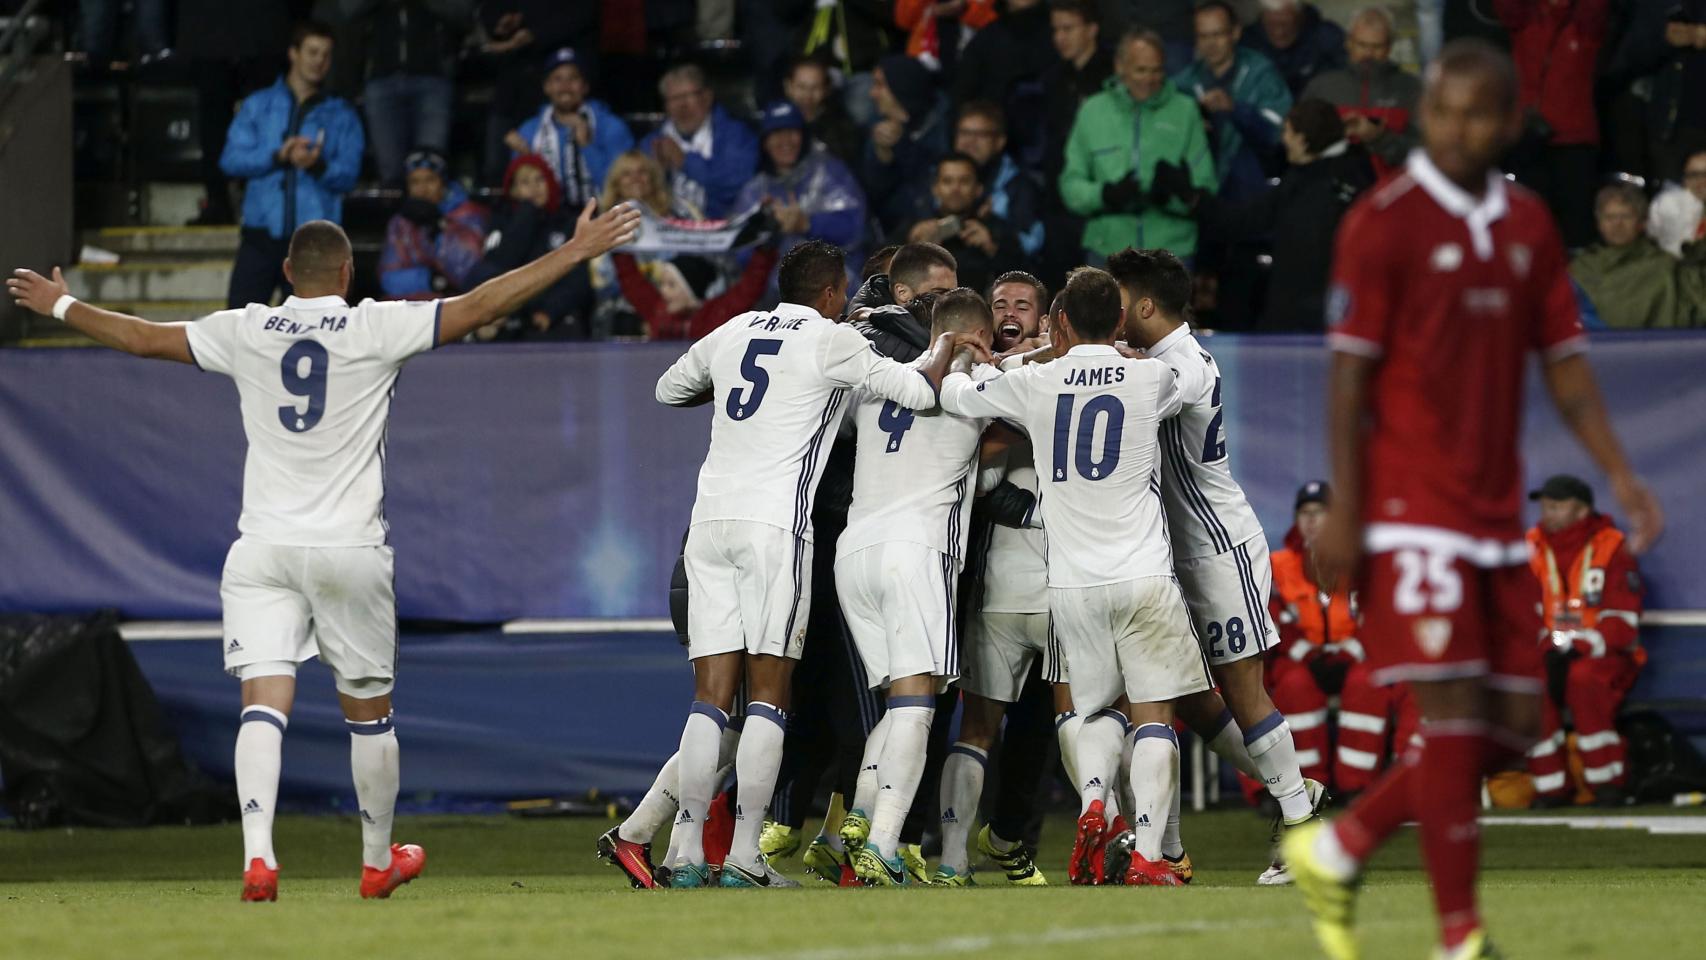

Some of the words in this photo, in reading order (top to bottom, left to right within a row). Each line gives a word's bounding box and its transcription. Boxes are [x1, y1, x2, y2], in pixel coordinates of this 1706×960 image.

[264, 316, 348, 334] BENMA
[278, 339, 329, 433] 9
[726, 338, 784, 421] 5
[1064, 366, 1126, 387] JAMES
[878, 399, 916, 453] 4
[1052, 393, 1126, 482] 10
[1393, 548, 1463, 614] 25
[1207, 616, 1247, 657] 28
